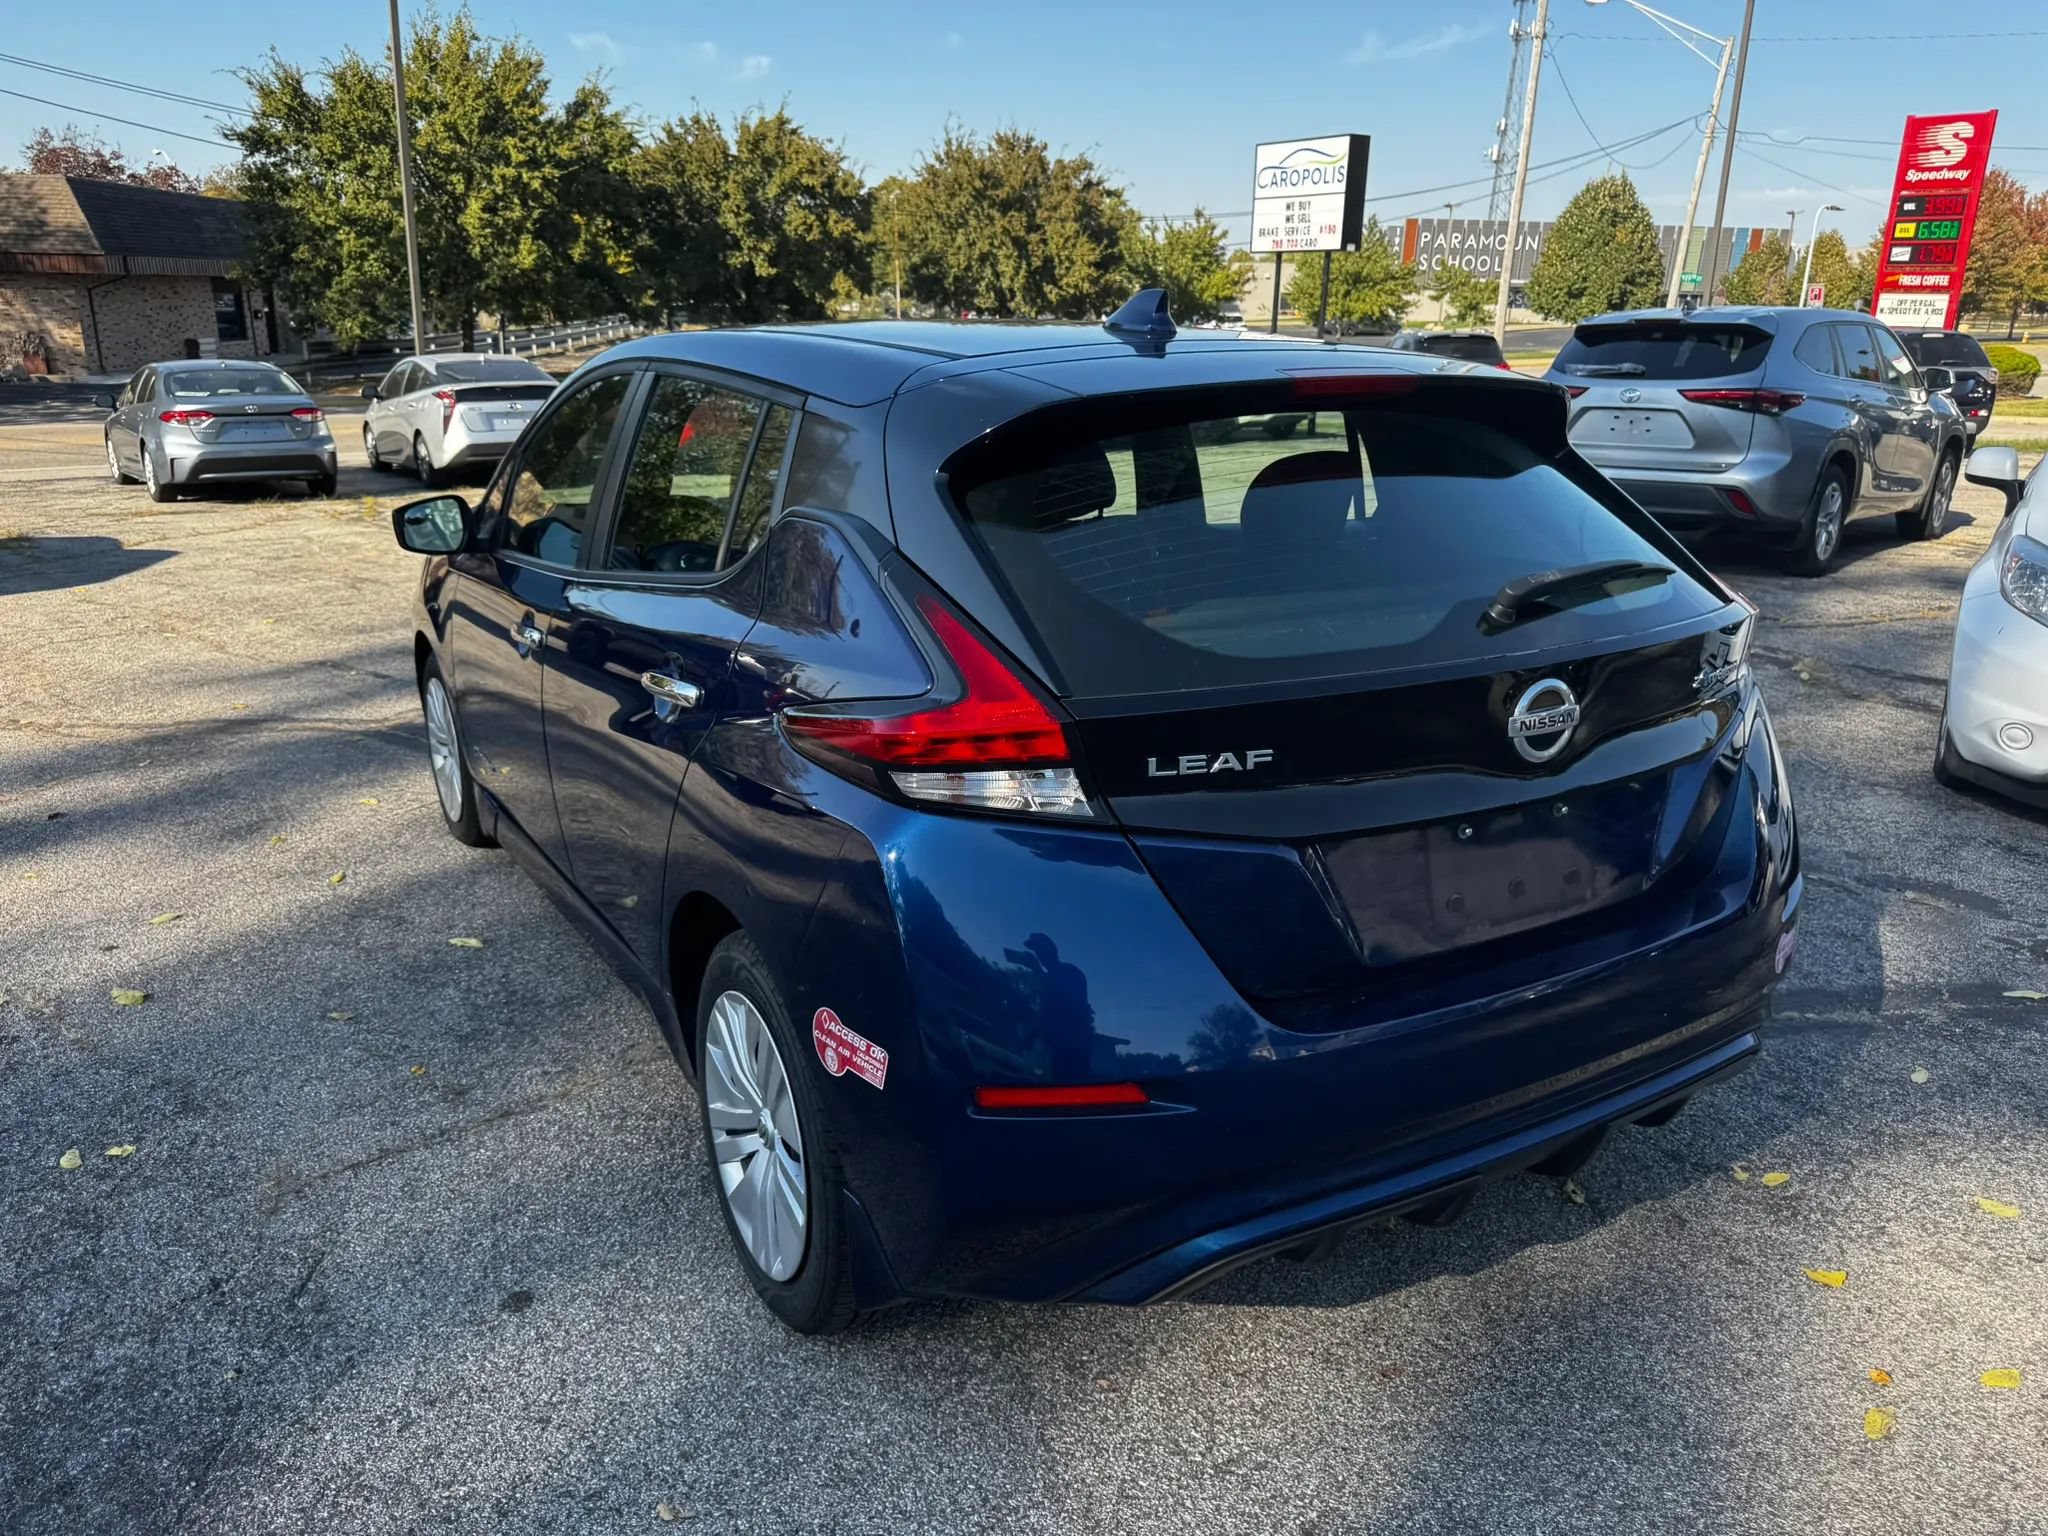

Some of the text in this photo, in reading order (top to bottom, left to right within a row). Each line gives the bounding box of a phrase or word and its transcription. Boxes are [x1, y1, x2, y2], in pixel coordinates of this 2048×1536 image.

[1257, 165, 1345, 189] CAROPOLIS
[1905, 168, 1972, 183] Speedway
[1285, 200, 1311, 212] WE BUY
[1285, 212, 1311, 224] WE SELL
[1258, 227, 1279, 238] BRAKE
[1284, 224, 1311, 236] SERVICE
[1898, 274, 1951, 286] FRESH COFFEE
[1519, 711, 1576, 733] NISSAN
[1147, 749, 1274, 777] LEAF
[828, 1021, 886, 1063] ACCESS OK
[814, 1029, 837, 1049] CLEAN
[838, 1046, 850, 1058] AIR
[852, 1054, 884, 1078] VEHICLE
